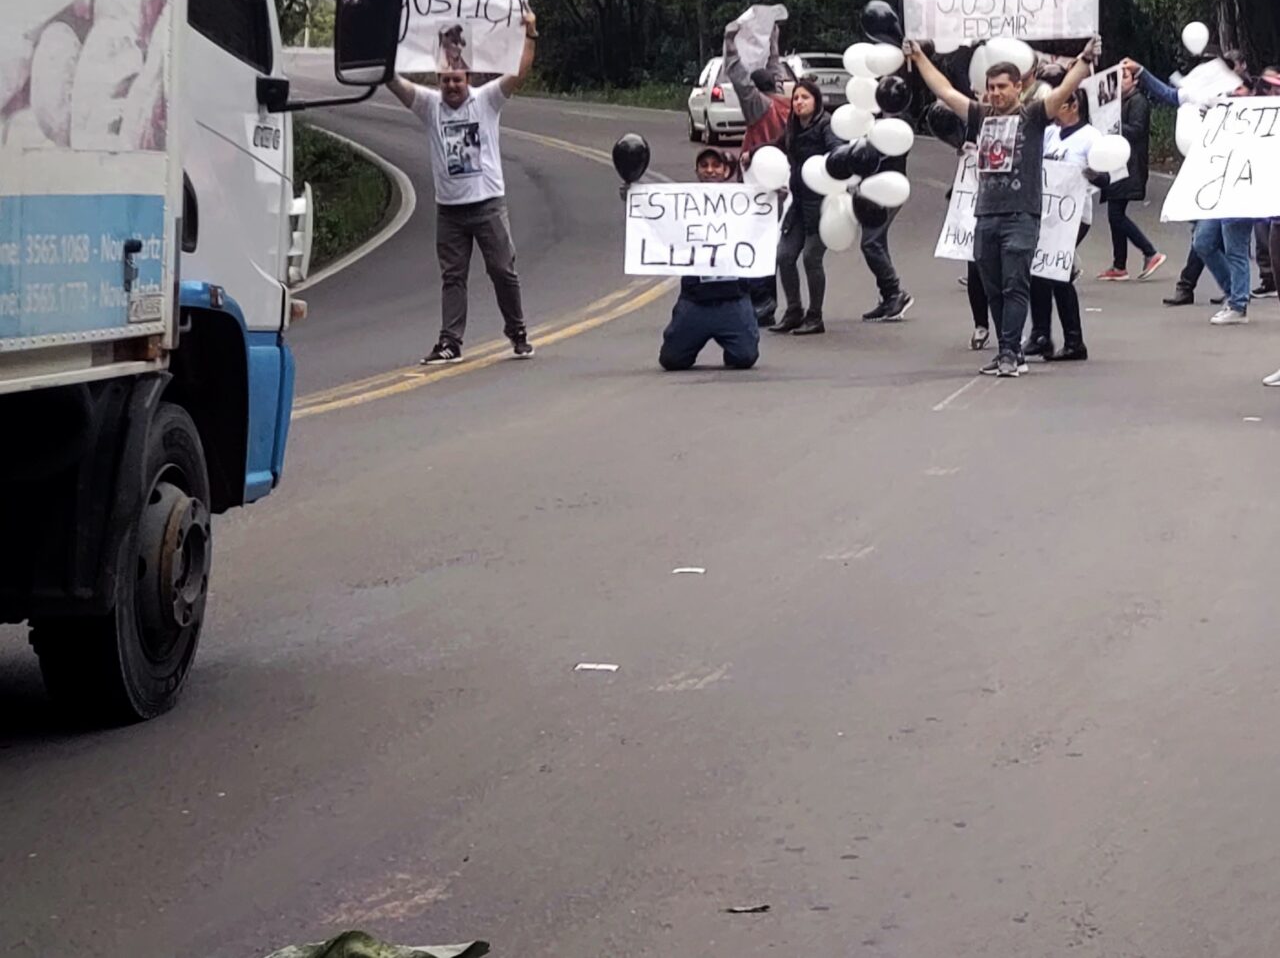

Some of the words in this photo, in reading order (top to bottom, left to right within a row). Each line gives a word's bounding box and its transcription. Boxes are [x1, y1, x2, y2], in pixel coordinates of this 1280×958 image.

[963, 15, 1027, 38] EDEMIR
[628, 191, 773, 221] ESTAMOS
[686, 222, 728, 242] EM
[640, 238, 756, 268] LUTO
